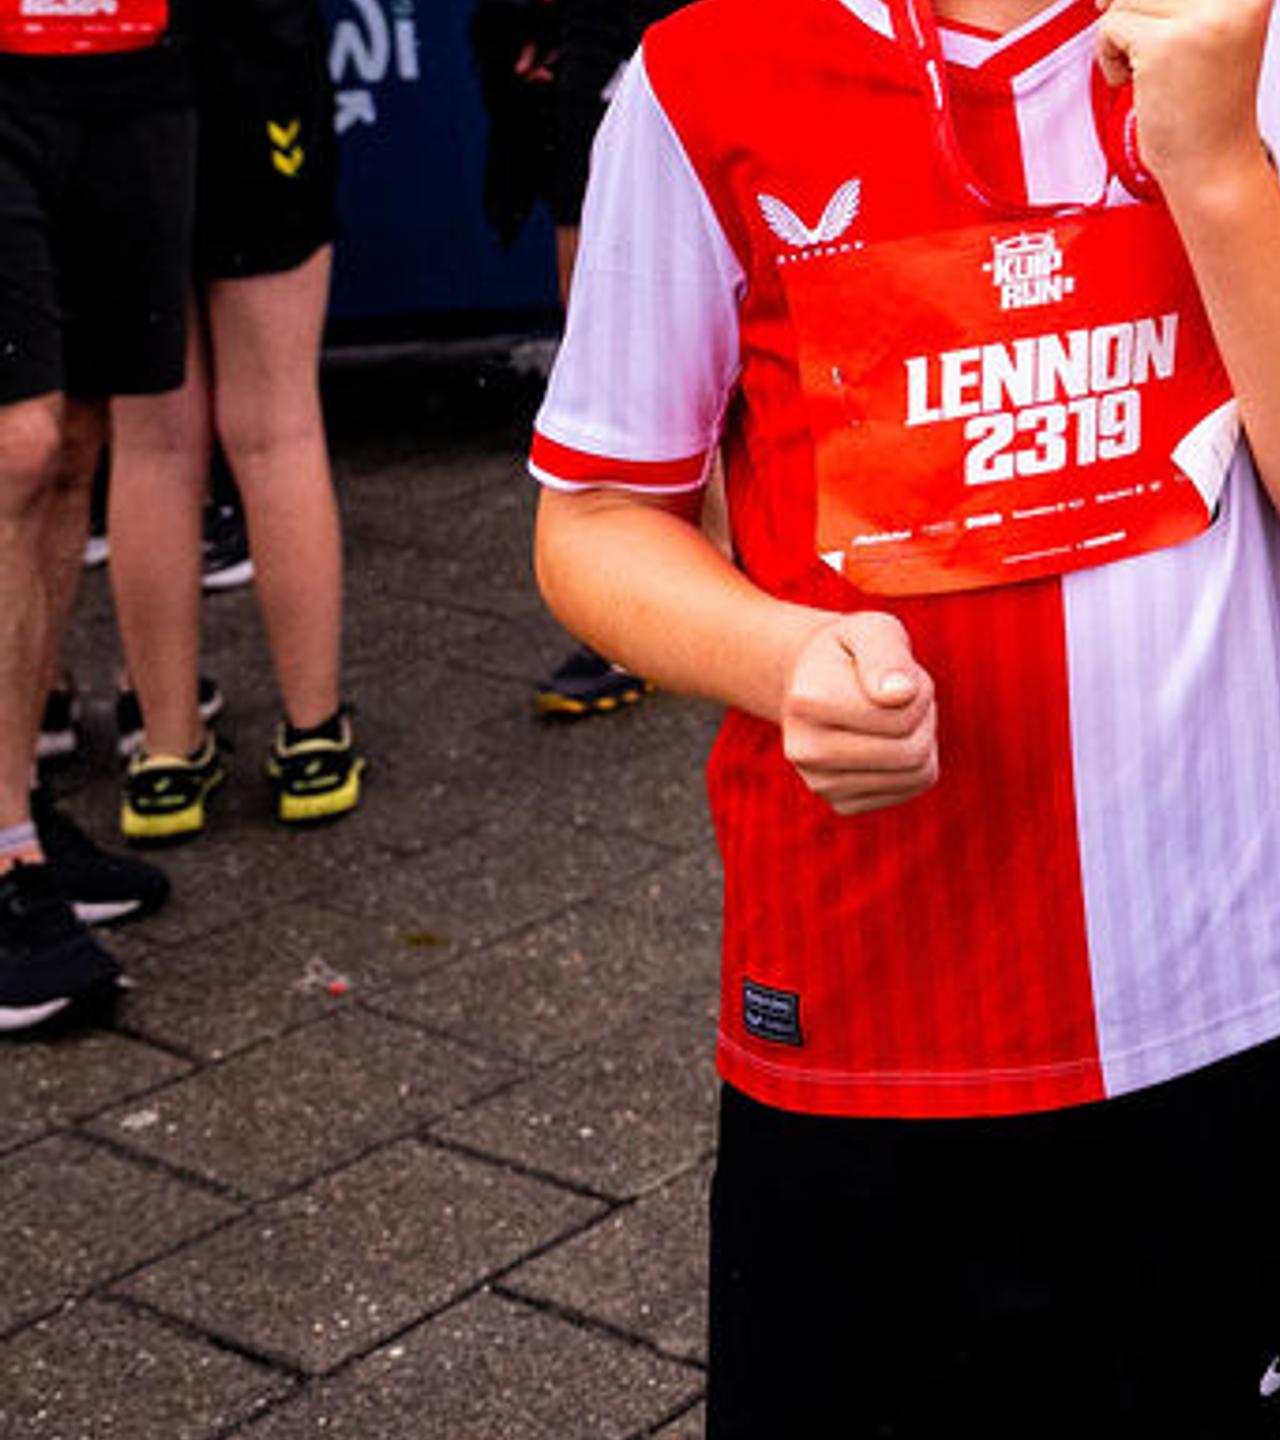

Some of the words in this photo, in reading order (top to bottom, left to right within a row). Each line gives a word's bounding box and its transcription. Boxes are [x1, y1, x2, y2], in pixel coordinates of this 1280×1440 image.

[994, 248, 1064, 286] KUIP
[1001, 275, 1063, 311] RUN
[904, 312, 1180, 427] LENNON
[963, 388, 1142, 486] 2319
